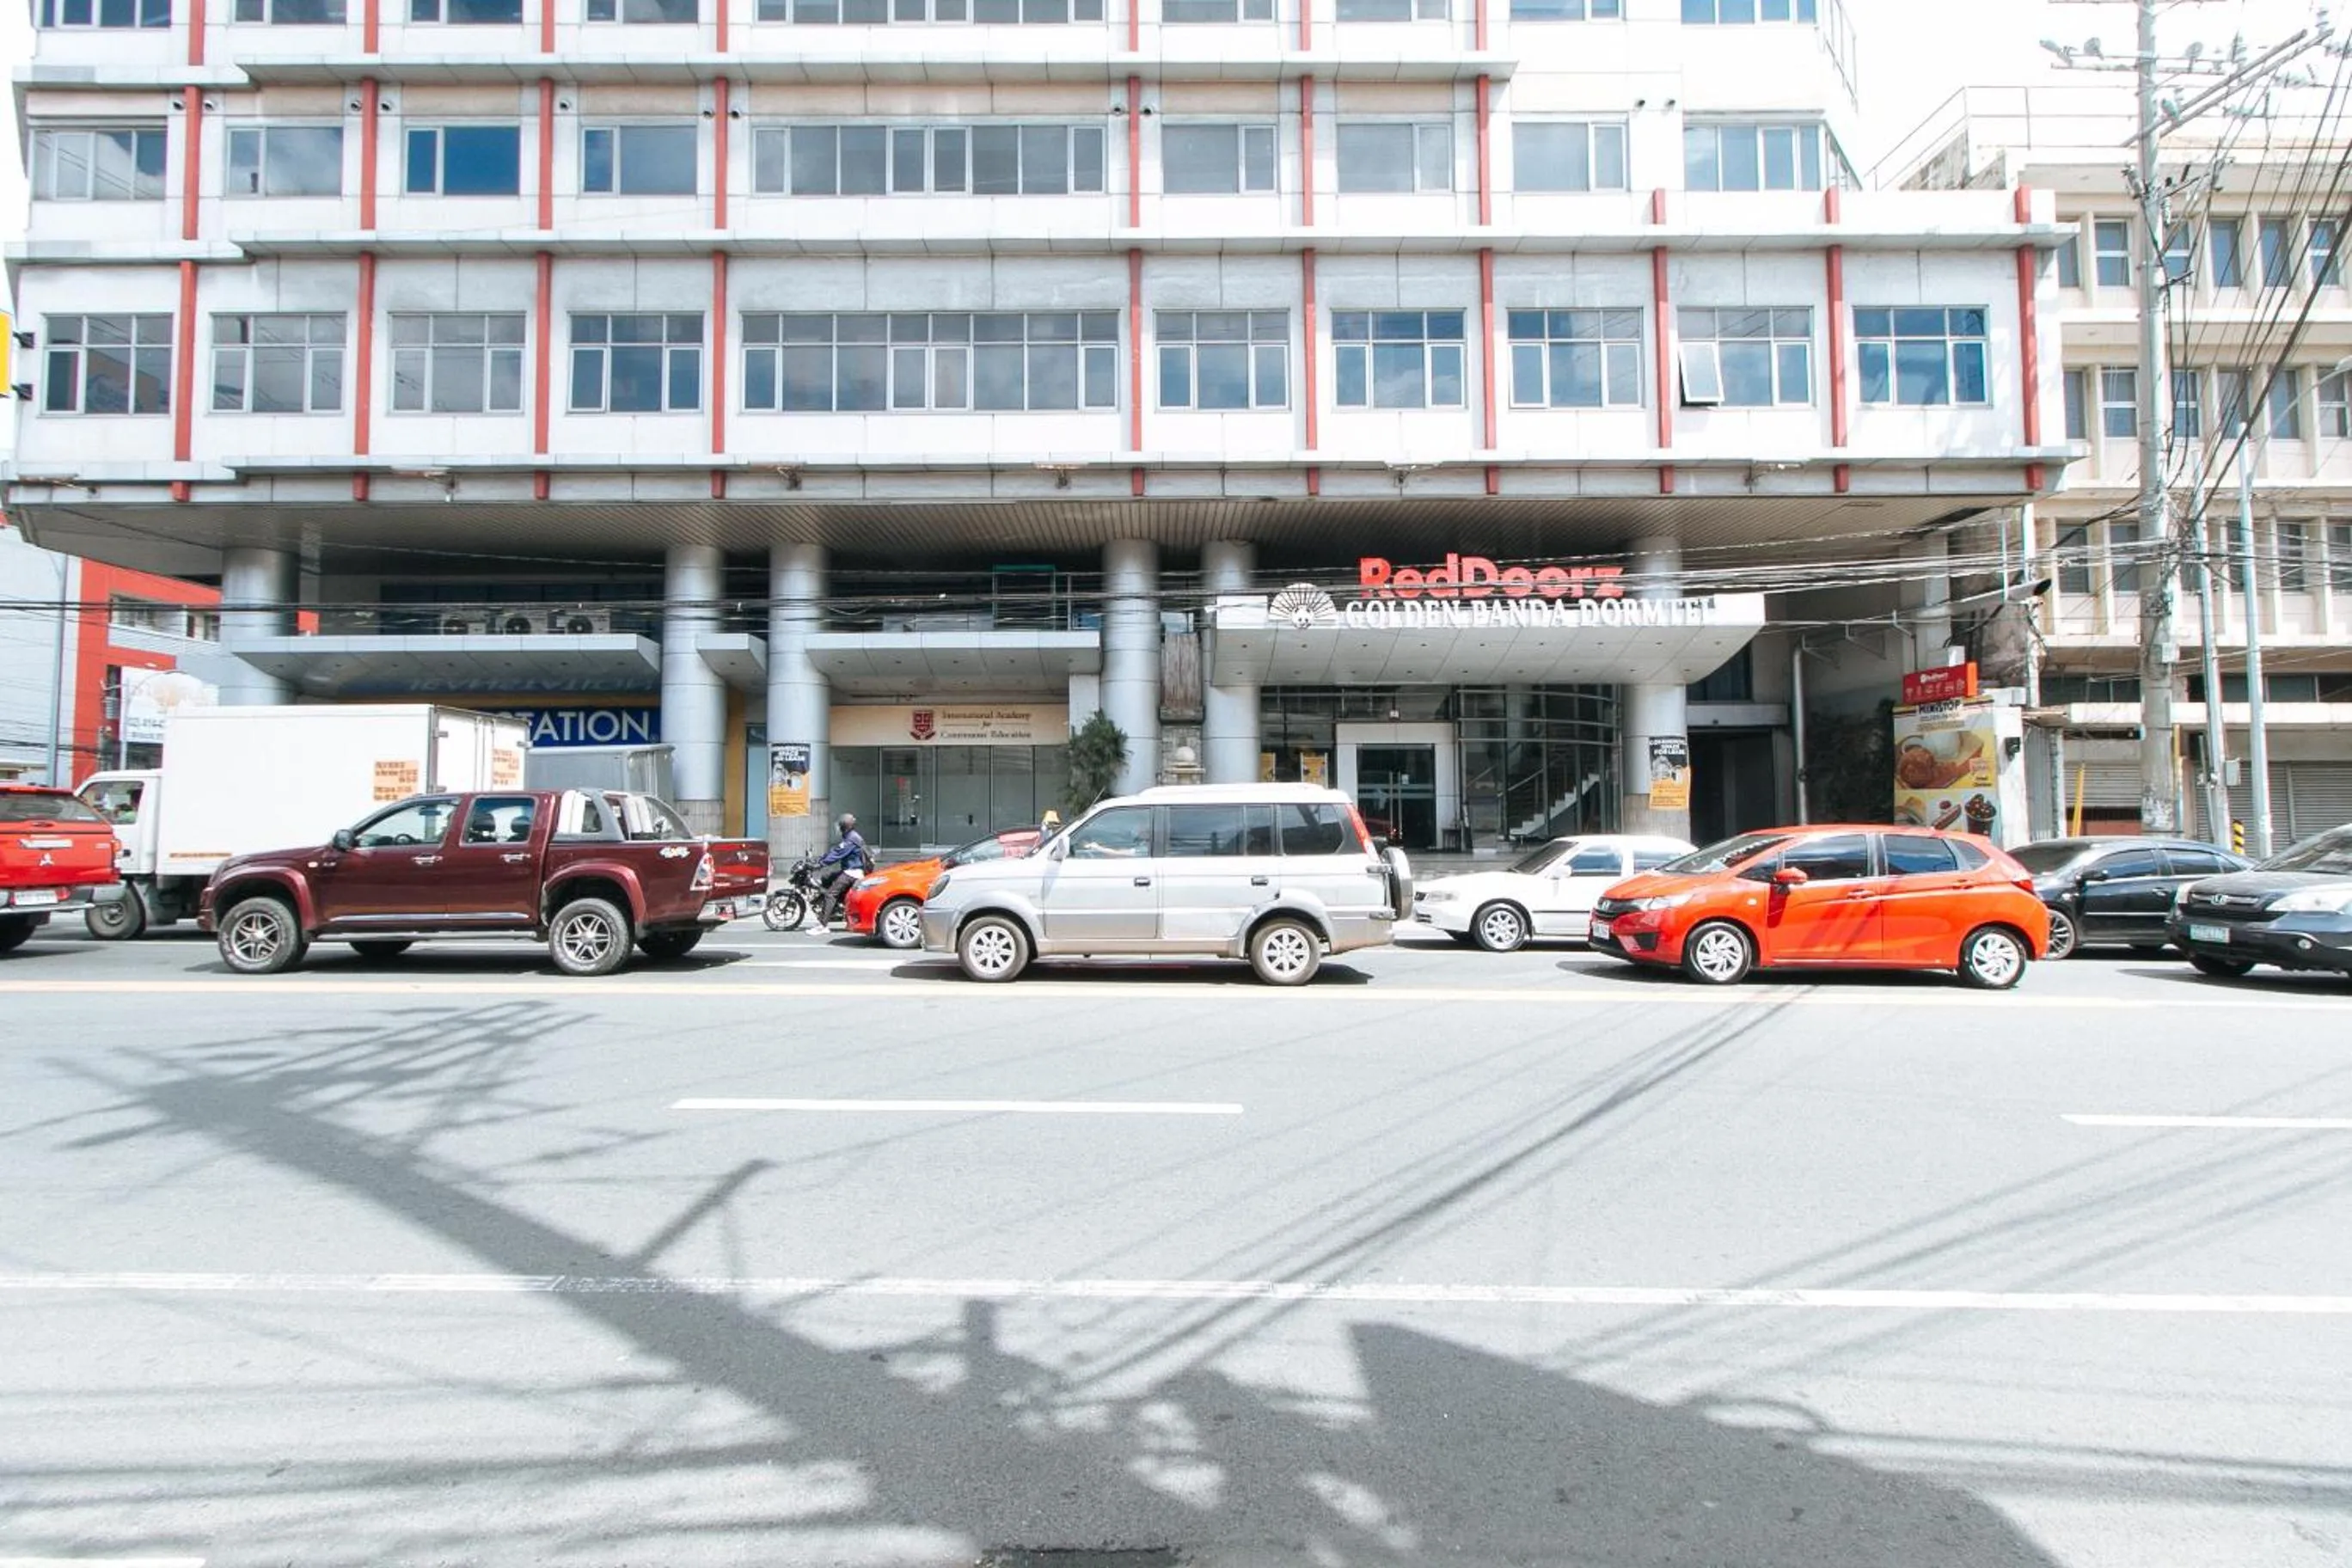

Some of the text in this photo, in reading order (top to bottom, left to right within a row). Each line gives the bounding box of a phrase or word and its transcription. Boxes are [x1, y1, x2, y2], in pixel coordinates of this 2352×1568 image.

[1360, 553, 1625, 599] RedDoorz
[1344, 600, 1461, 628] GOLDEN
[1471, 598, 1567, 628] PANDA
[942, 711, 1032, 721] International Academy
